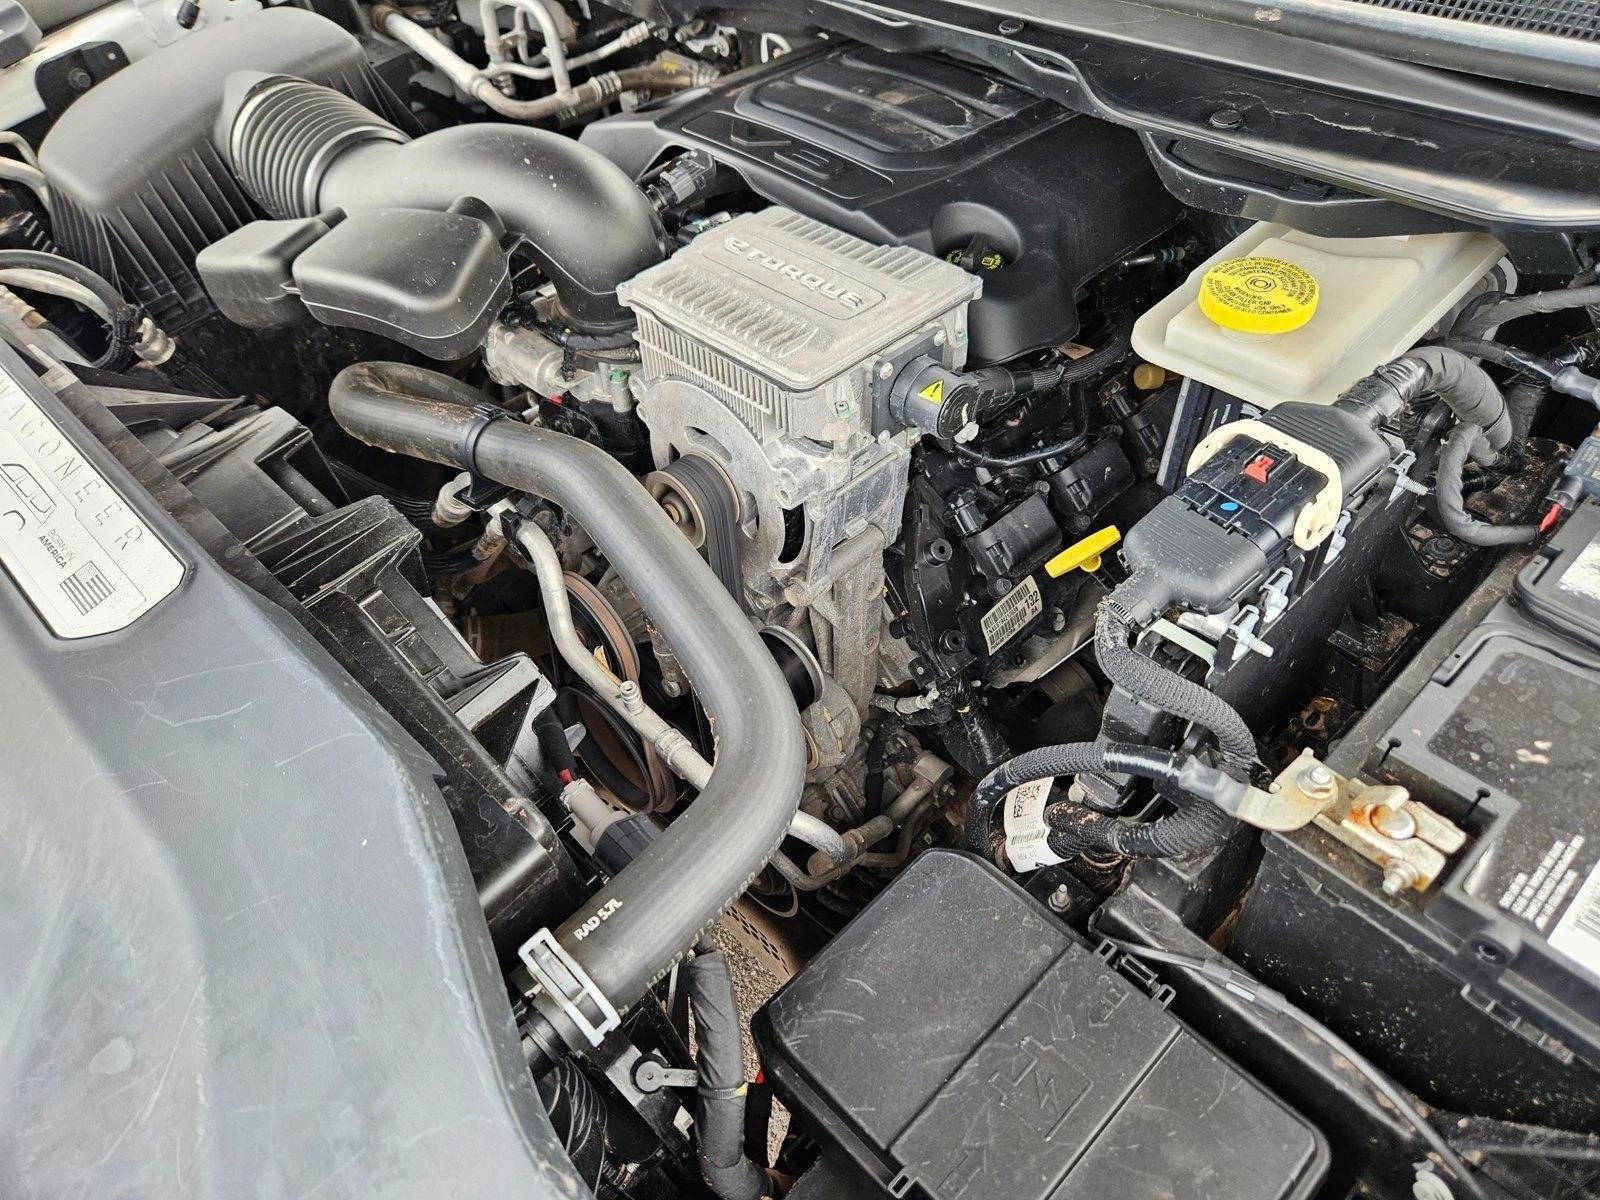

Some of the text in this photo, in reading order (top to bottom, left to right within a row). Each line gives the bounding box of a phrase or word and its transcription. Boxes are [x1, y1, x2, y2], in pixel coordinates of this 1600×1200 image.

[38, 534, 68, 569] AMERICA
[47, 528, 68, 553] BORN
[1024, 590, 1040, 610] 132
[573, 898, 624, 941] RAD 5.7L
